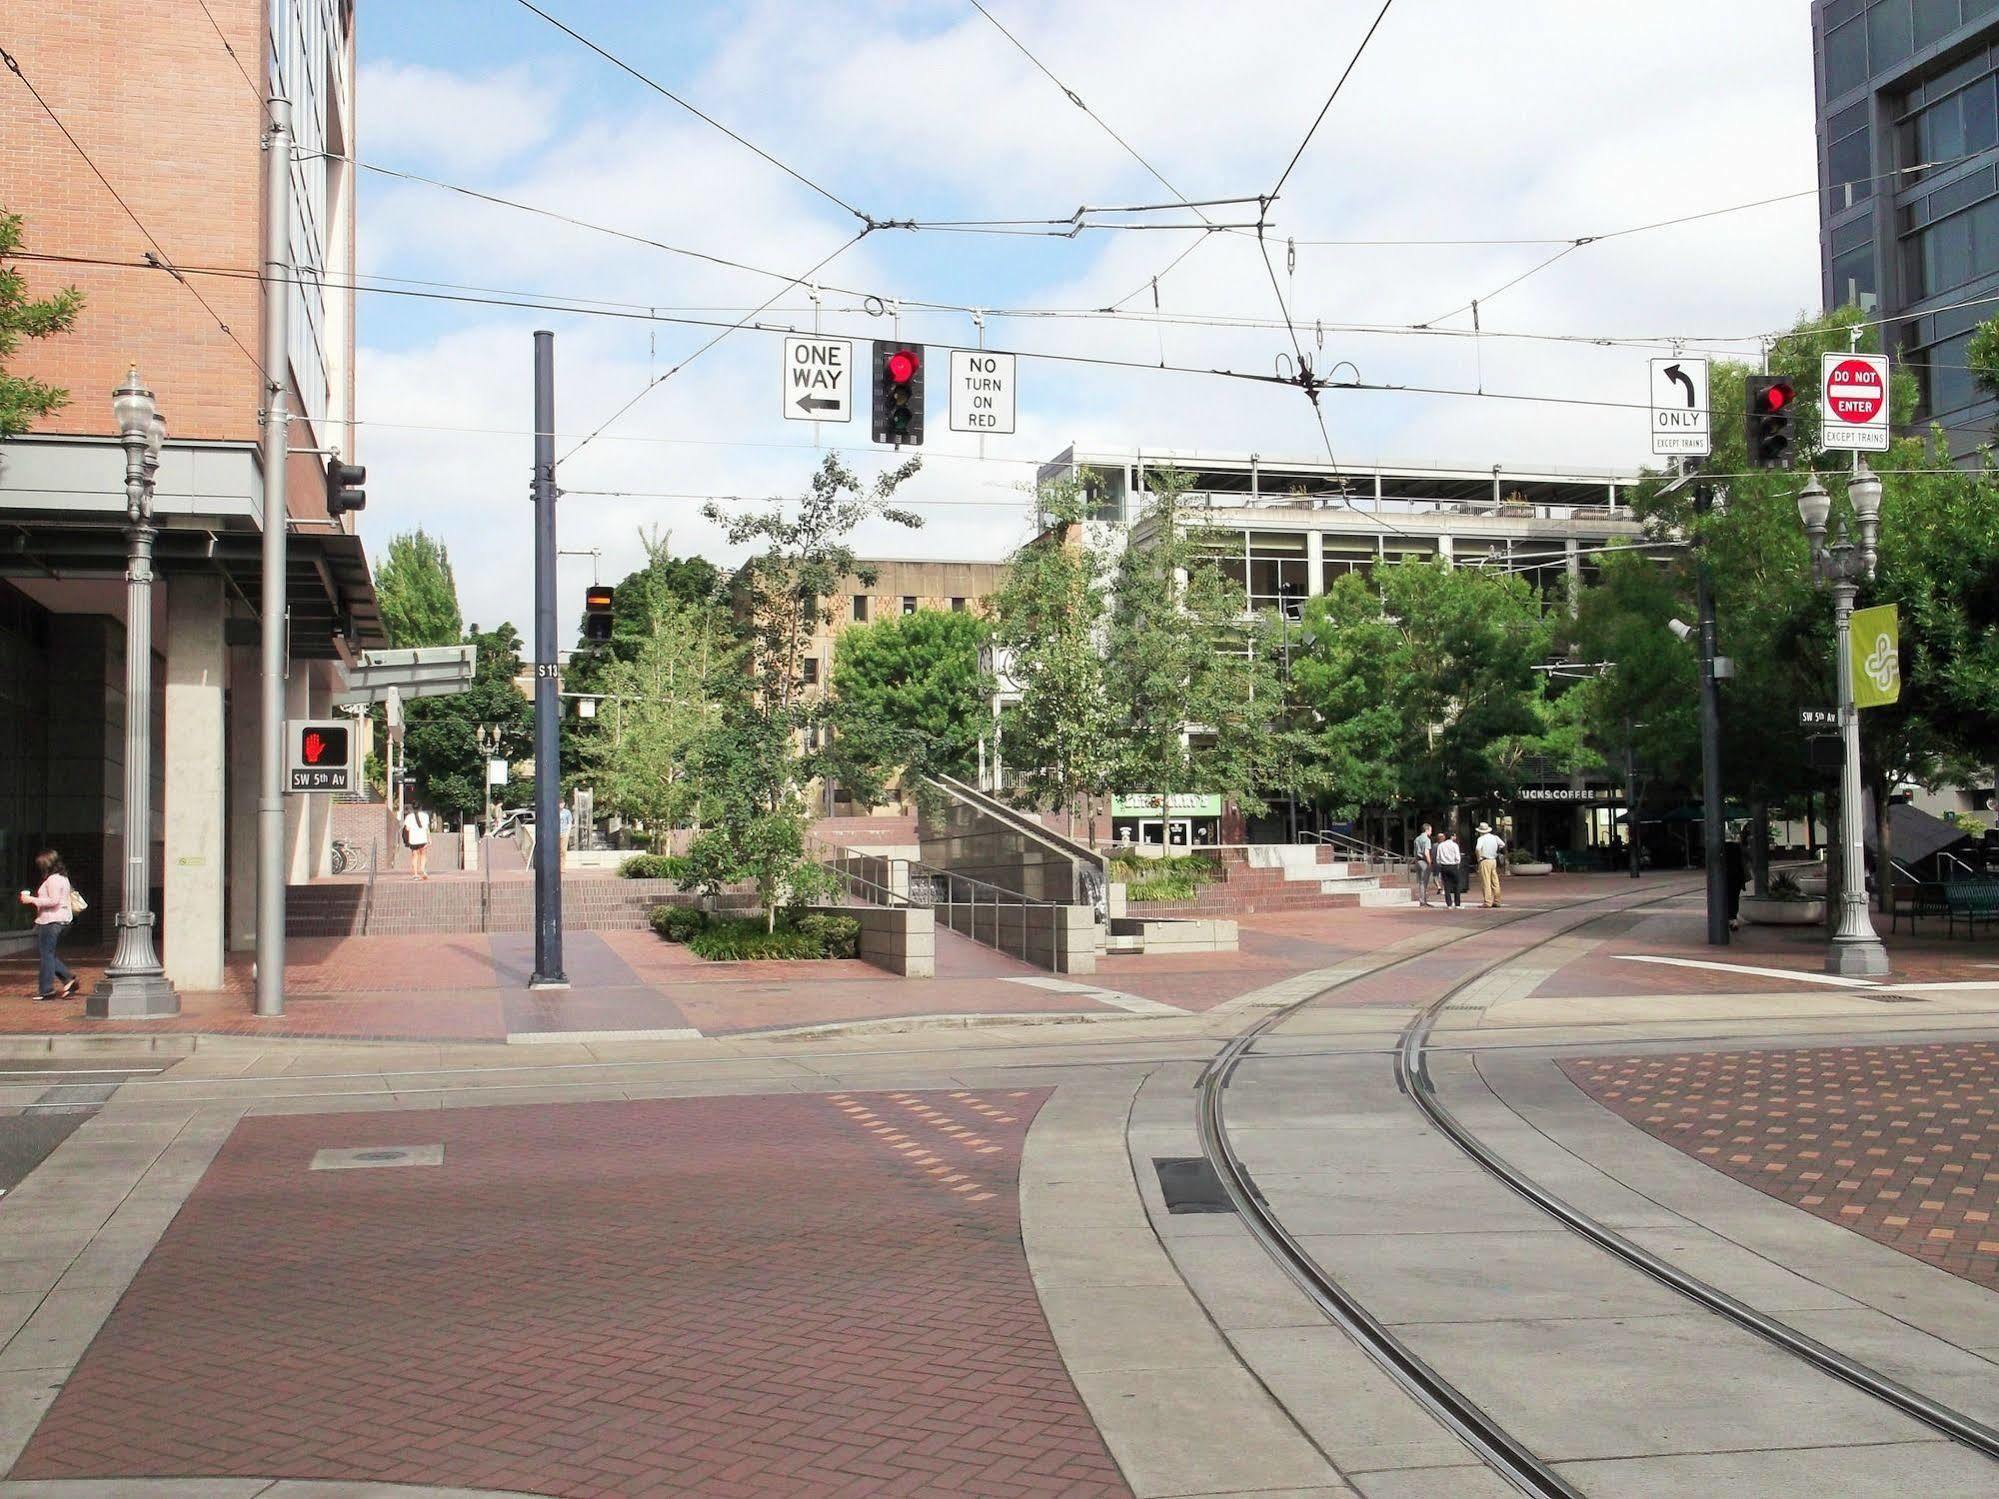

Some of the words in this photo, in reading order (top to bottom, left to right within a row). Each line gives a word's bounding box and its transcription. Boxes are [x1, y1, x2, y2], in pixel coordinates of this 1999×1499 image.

[795, 344, 842, 366] ONE
[970, 358, 997, 374] NO
[793, 368, 843, 390] WAY
[1834, 370, 1850, 382] DO
[1855, 371, 1877, 383] NOT
[965, 377, 1002, 392] TURN
[973, 396, 993, 409] ON
[1838, 400, 1873, 413] ENTER
[968, 413, 996, 428] RED
[1659, 412, 1700, 427] ONLY
[1657, 439, 1679, 448] EXCEPT
[1682, 439, 1704, 448] TRAINS
[1827, 431, 1855, 443] EXCEPT
[1858, 432, 1885, 444] TRAINS
[1802, 711, 1813, 723] SW
[1815, 711, 1825, 723] 5th
[1827, 712, 1836, 723] Av
[294, 773, 310, 786] SW
[313, 772, 329, 786] 5th
[332, 773, 345, 786] Av
[1553, 789, 1594, 799] COFFEE
